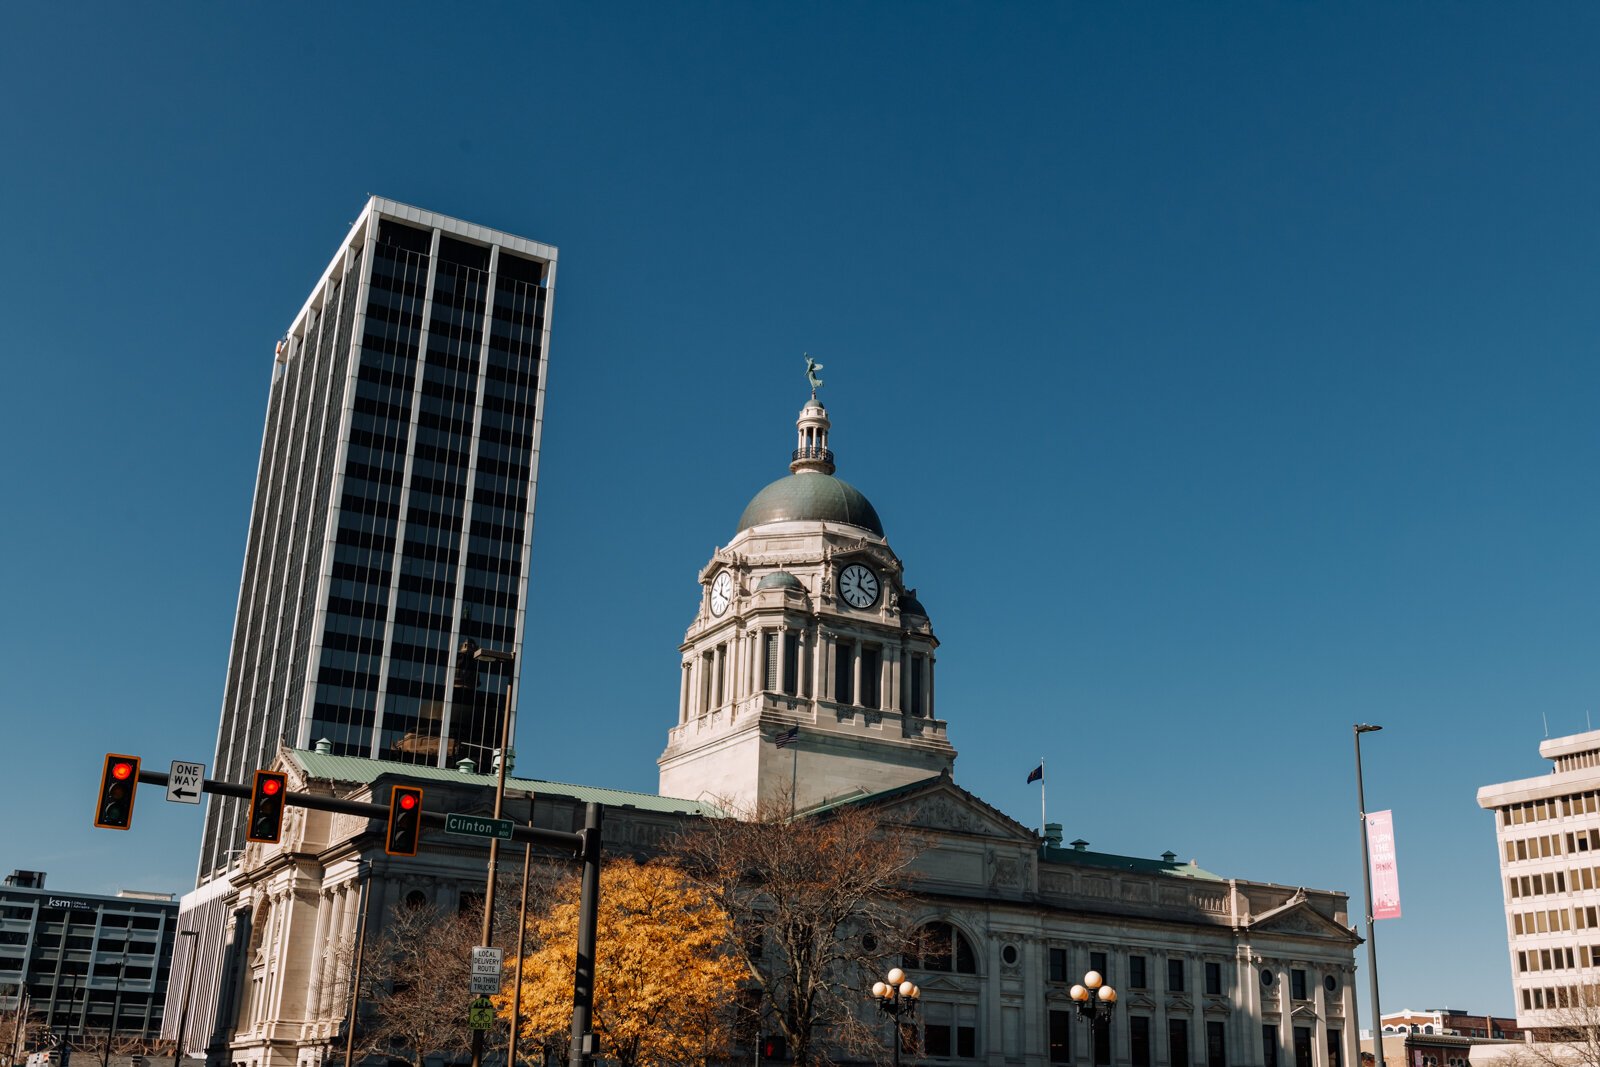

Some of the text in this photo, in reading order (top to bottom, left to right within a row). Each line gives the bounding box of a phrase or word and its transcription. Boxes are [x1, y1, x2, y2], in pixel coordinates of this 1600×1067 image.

[176, 764, 199, 776] ONE
[174, 775, 199, 787] WAY
[449, 818, 492, 833] Clinton
[1372, 832, 1392, 844] TURN
[1374, 844, 1390, 853] THE
[1372, 853, 1394, 863] TOWN
[1375, 862, 1392, 872] PINK
[48, 896, 70, 908] ksm
[478, 950, 496, 958] LOCAL
[474, 957, 500, 965] DELIVERY
[477, 965, 496, 973] ROUTE
[473, 976, 498, 984] NO THRU
[474, 983, 496, 992] TRUCKS
